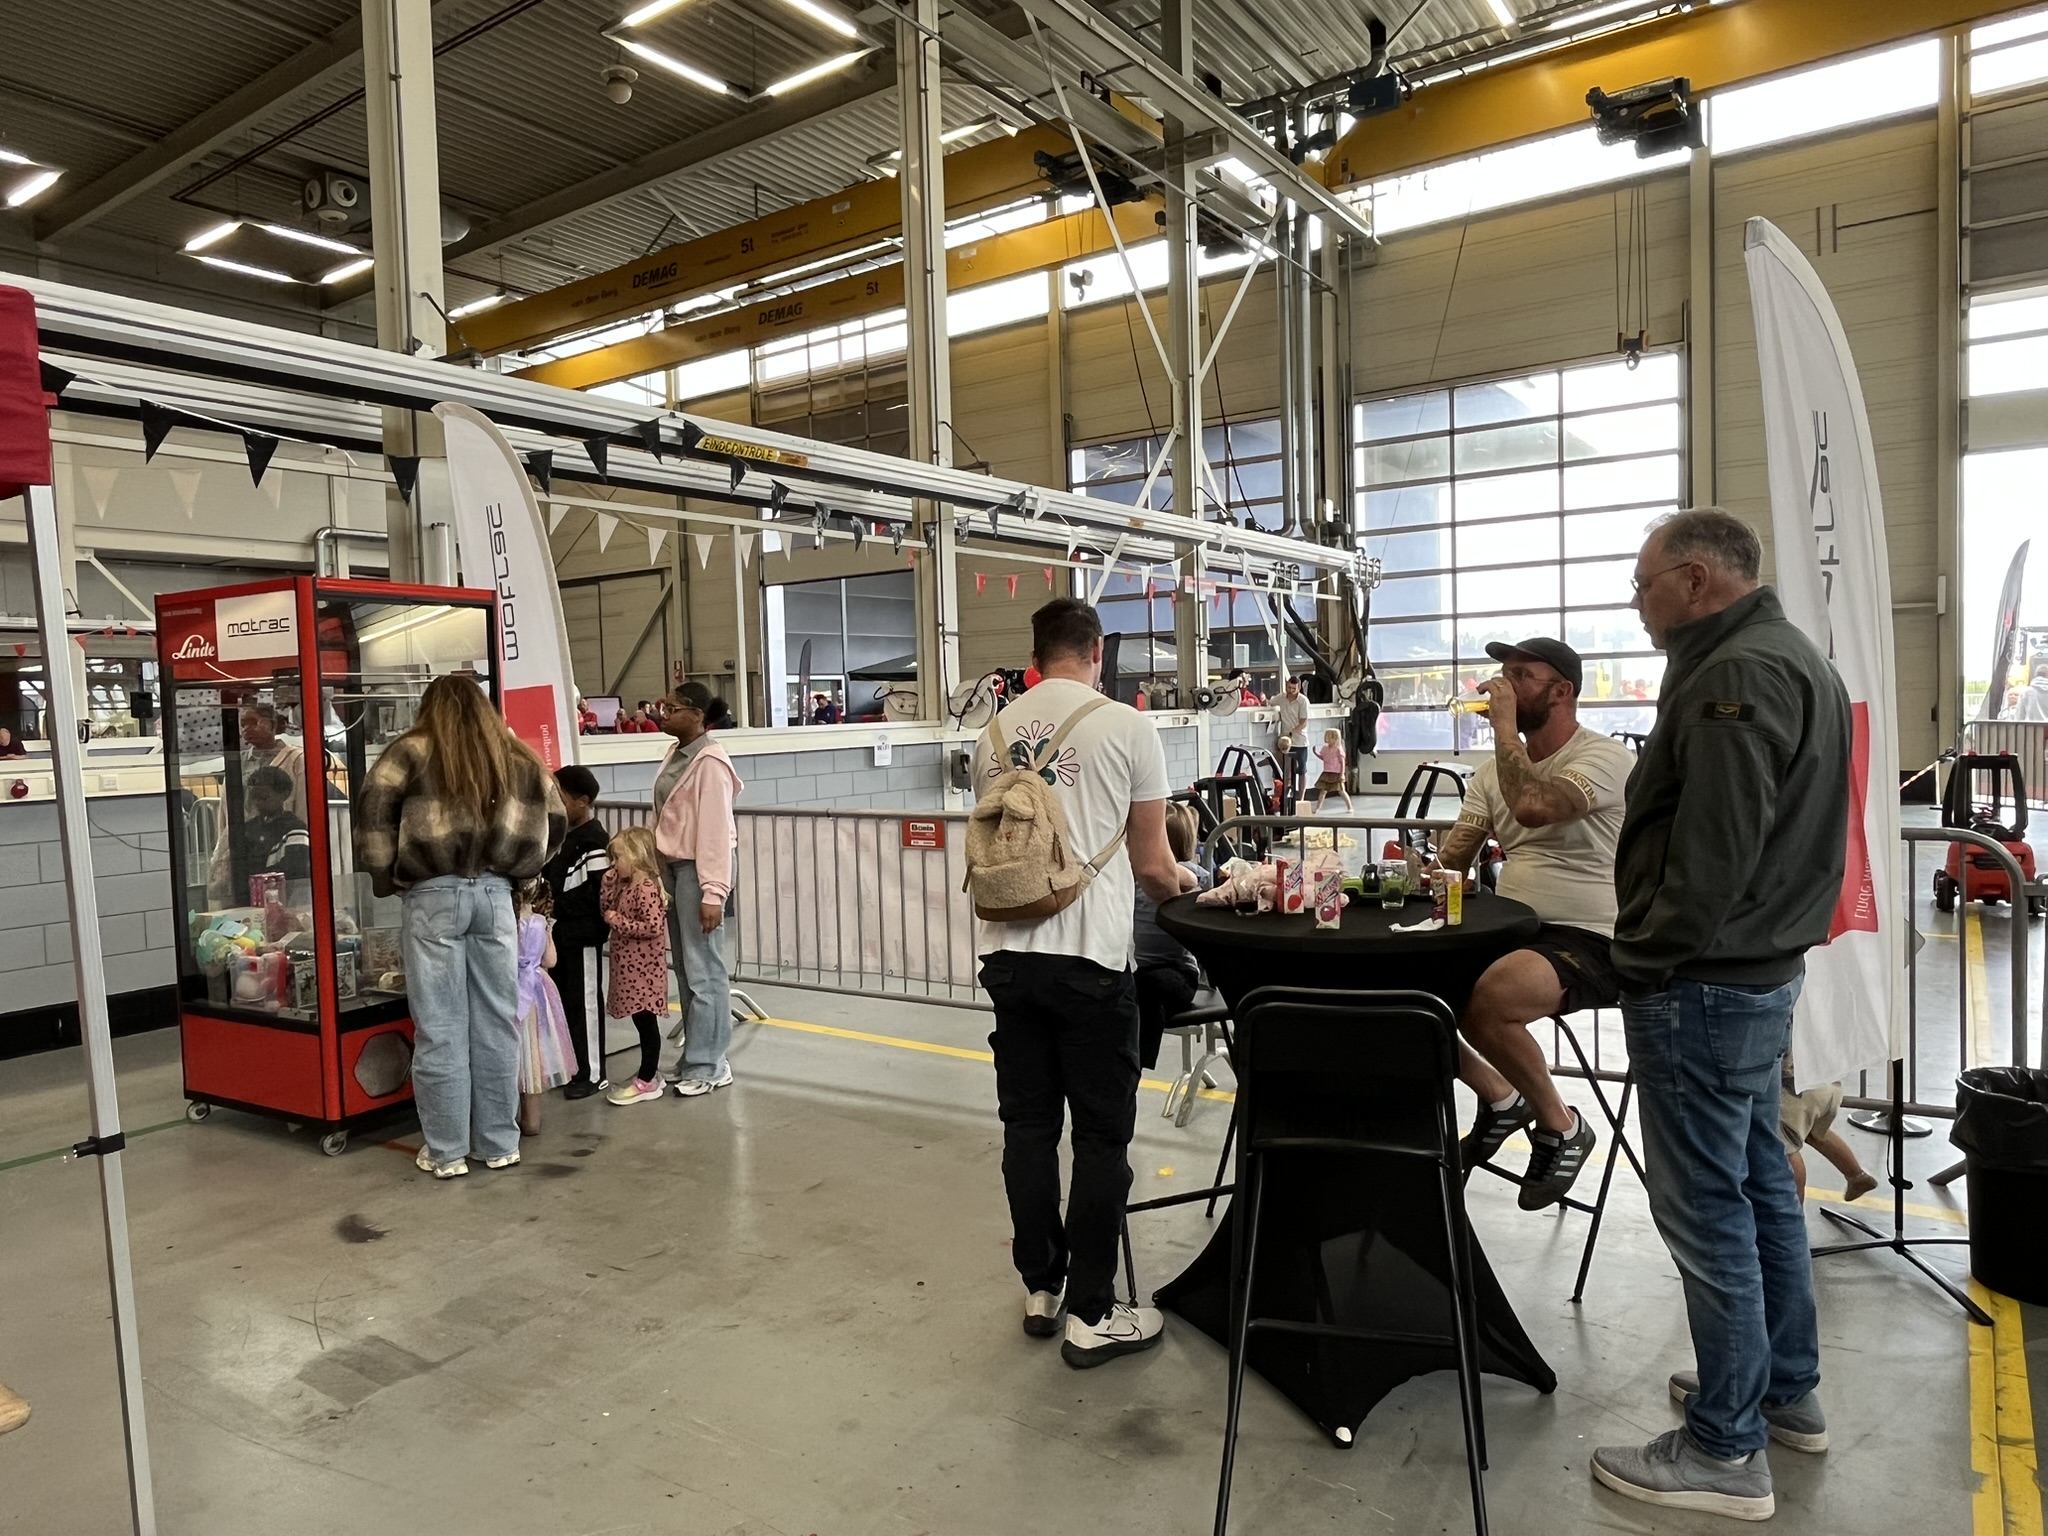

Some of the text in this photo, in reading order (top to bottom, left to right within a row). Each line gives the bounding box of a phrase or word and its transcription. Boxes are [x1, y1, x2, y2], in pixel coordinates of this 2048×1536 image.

[740, 237, 755, 254] 5t
[632, 262, 677, 289] DEMAG
[866, 281, 880, 296] 5t
[759, 302, 803, 326] DEMAG
[703, 438, 773, 460] EINDCONTROLE
[227, 617, 290, 635] motrac
[172, 634, 216, 660] Linde
